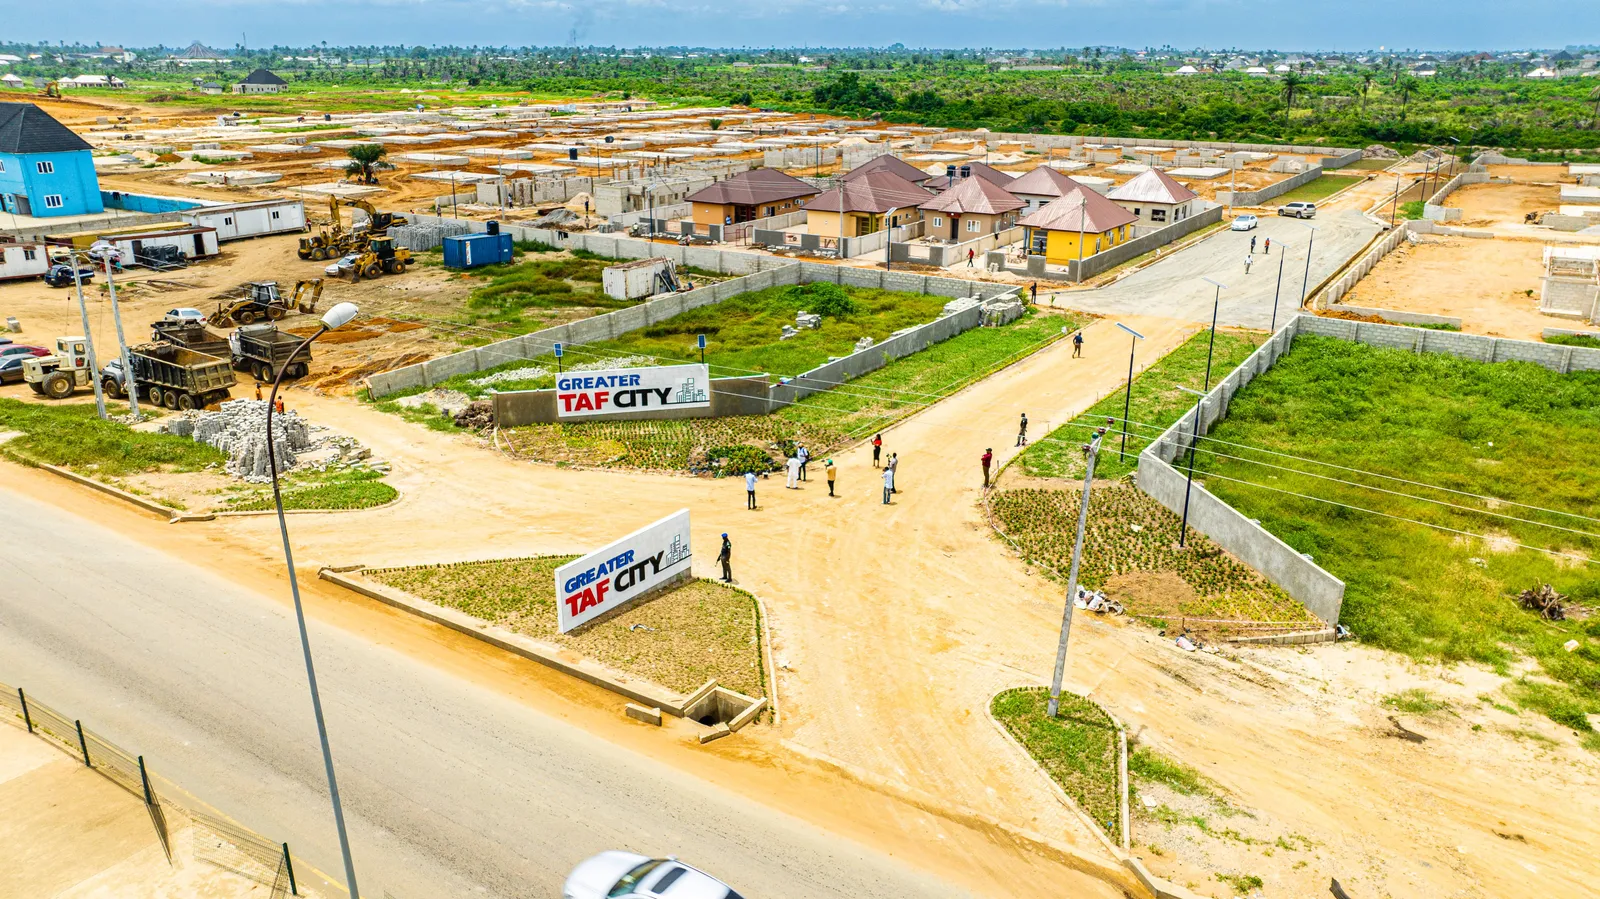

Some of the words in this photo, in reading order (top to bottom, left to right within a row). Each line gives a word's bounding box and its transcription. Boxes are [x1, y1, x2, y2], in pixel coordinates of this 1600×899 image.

[558, 374, 641, 391] GREATER
[558, 391, 609, 412] TAF
[613, 387, 672, 408] CITY
[564, 549, 635, 594] GREATER
[565, 578, 610, 617] TAF
[614, 550, 665, 592] CITY
